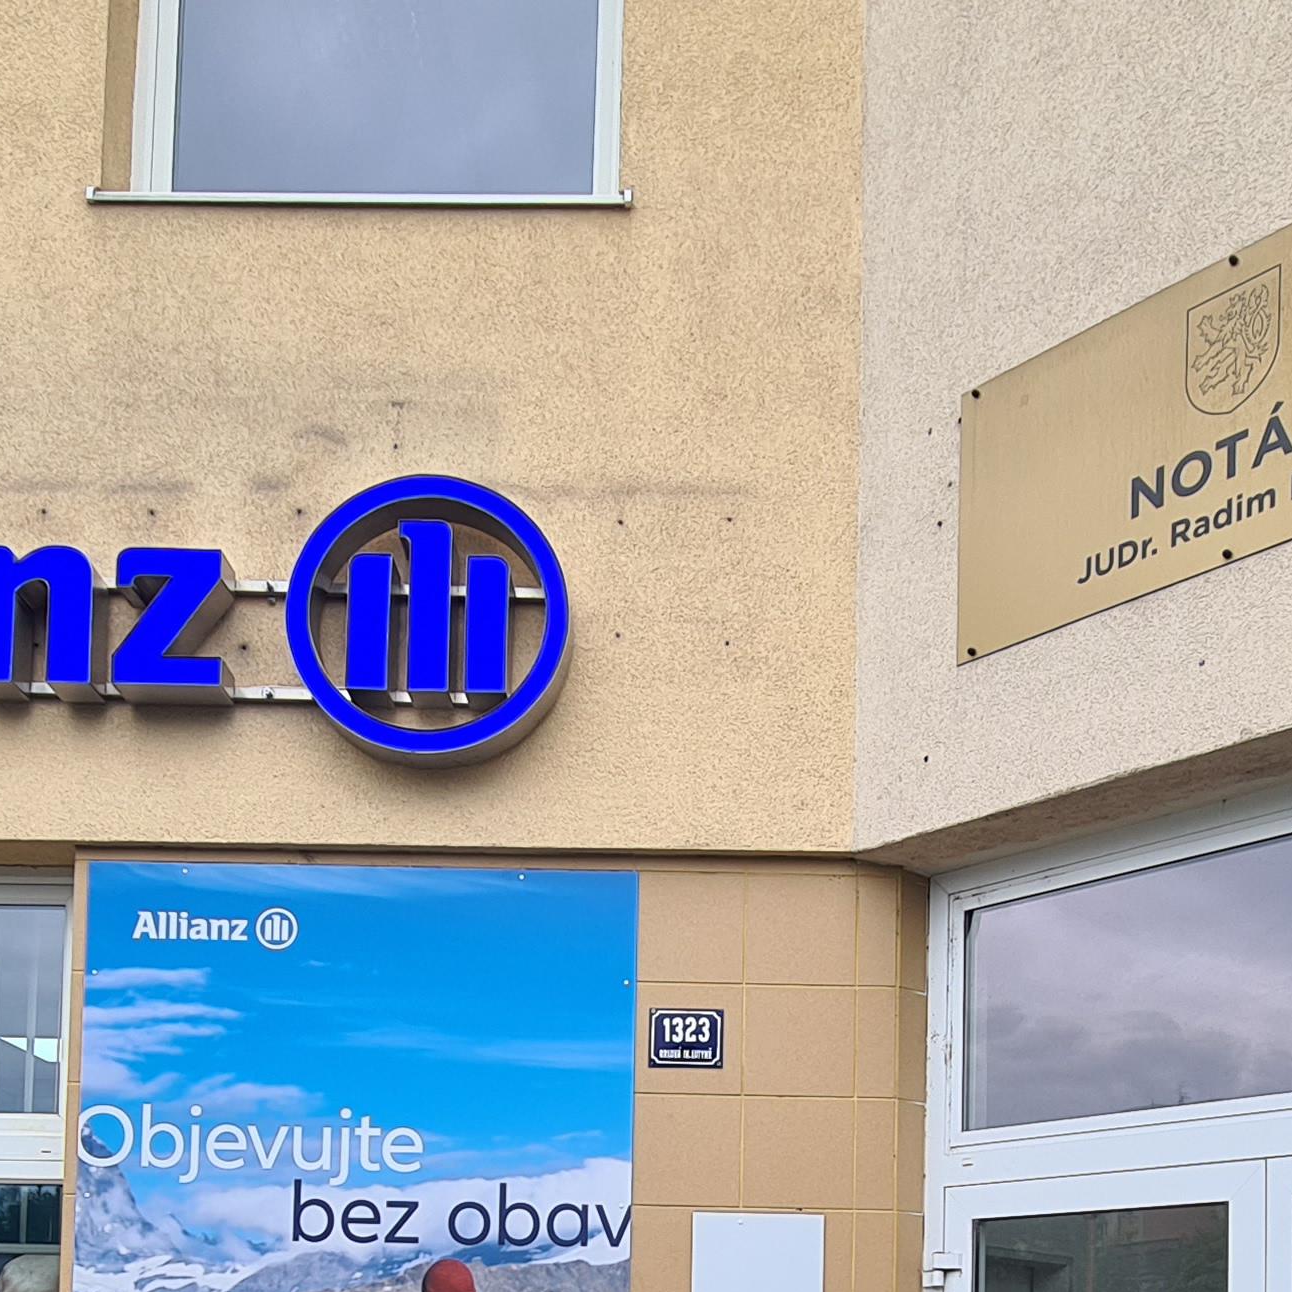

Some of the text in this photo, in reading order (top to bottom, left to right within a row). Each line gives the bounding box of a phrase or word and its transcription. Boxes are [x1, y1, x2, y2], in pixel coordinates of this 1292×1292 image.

[1077, 537, 1158, 585] JUDr.
[1171, 486, 1276, 546] Radim
[132, 910, 248, 941] Allianz
[663, 1016, 710, 1043] 1323
[77, 1103, 424, 1187] Objevujte
[292, 1179, 631, 1248] bez obav
